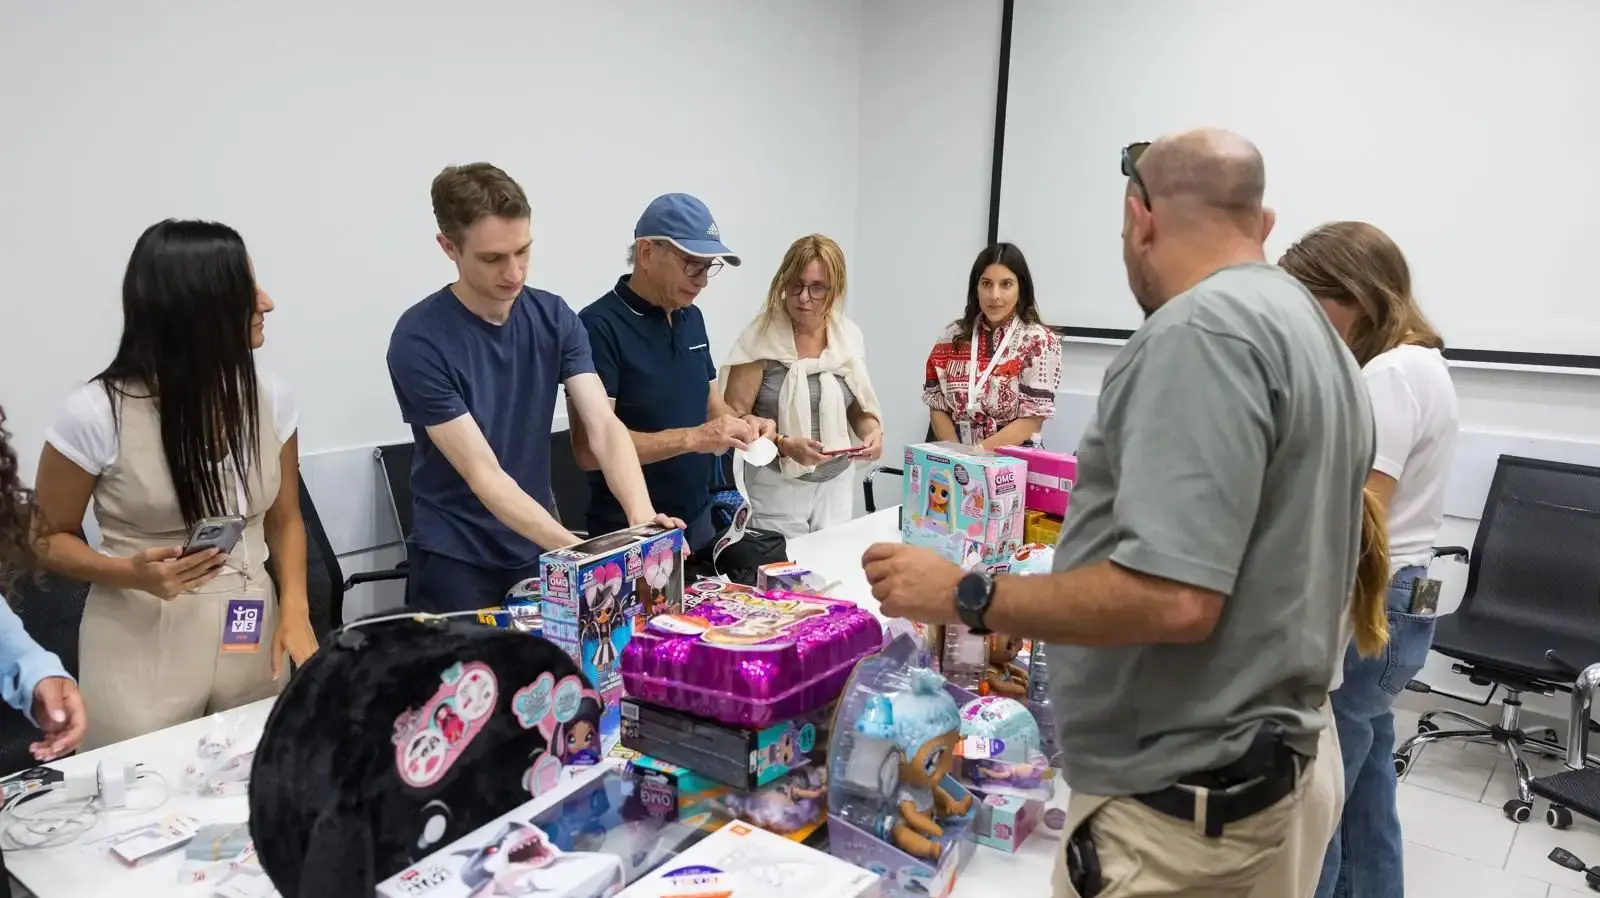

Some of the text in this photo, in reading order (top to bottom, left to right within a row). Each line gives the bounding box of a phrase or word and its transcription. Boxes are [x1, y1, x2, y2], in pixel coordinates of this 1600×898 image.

[995, 471, 1015, 485] OMG
[550, 576, 569, 587] OMG
[583, 570, 594, 583] 25
[630, 595, 636, 606] 2
[641, 790, 671, 807] OMG
